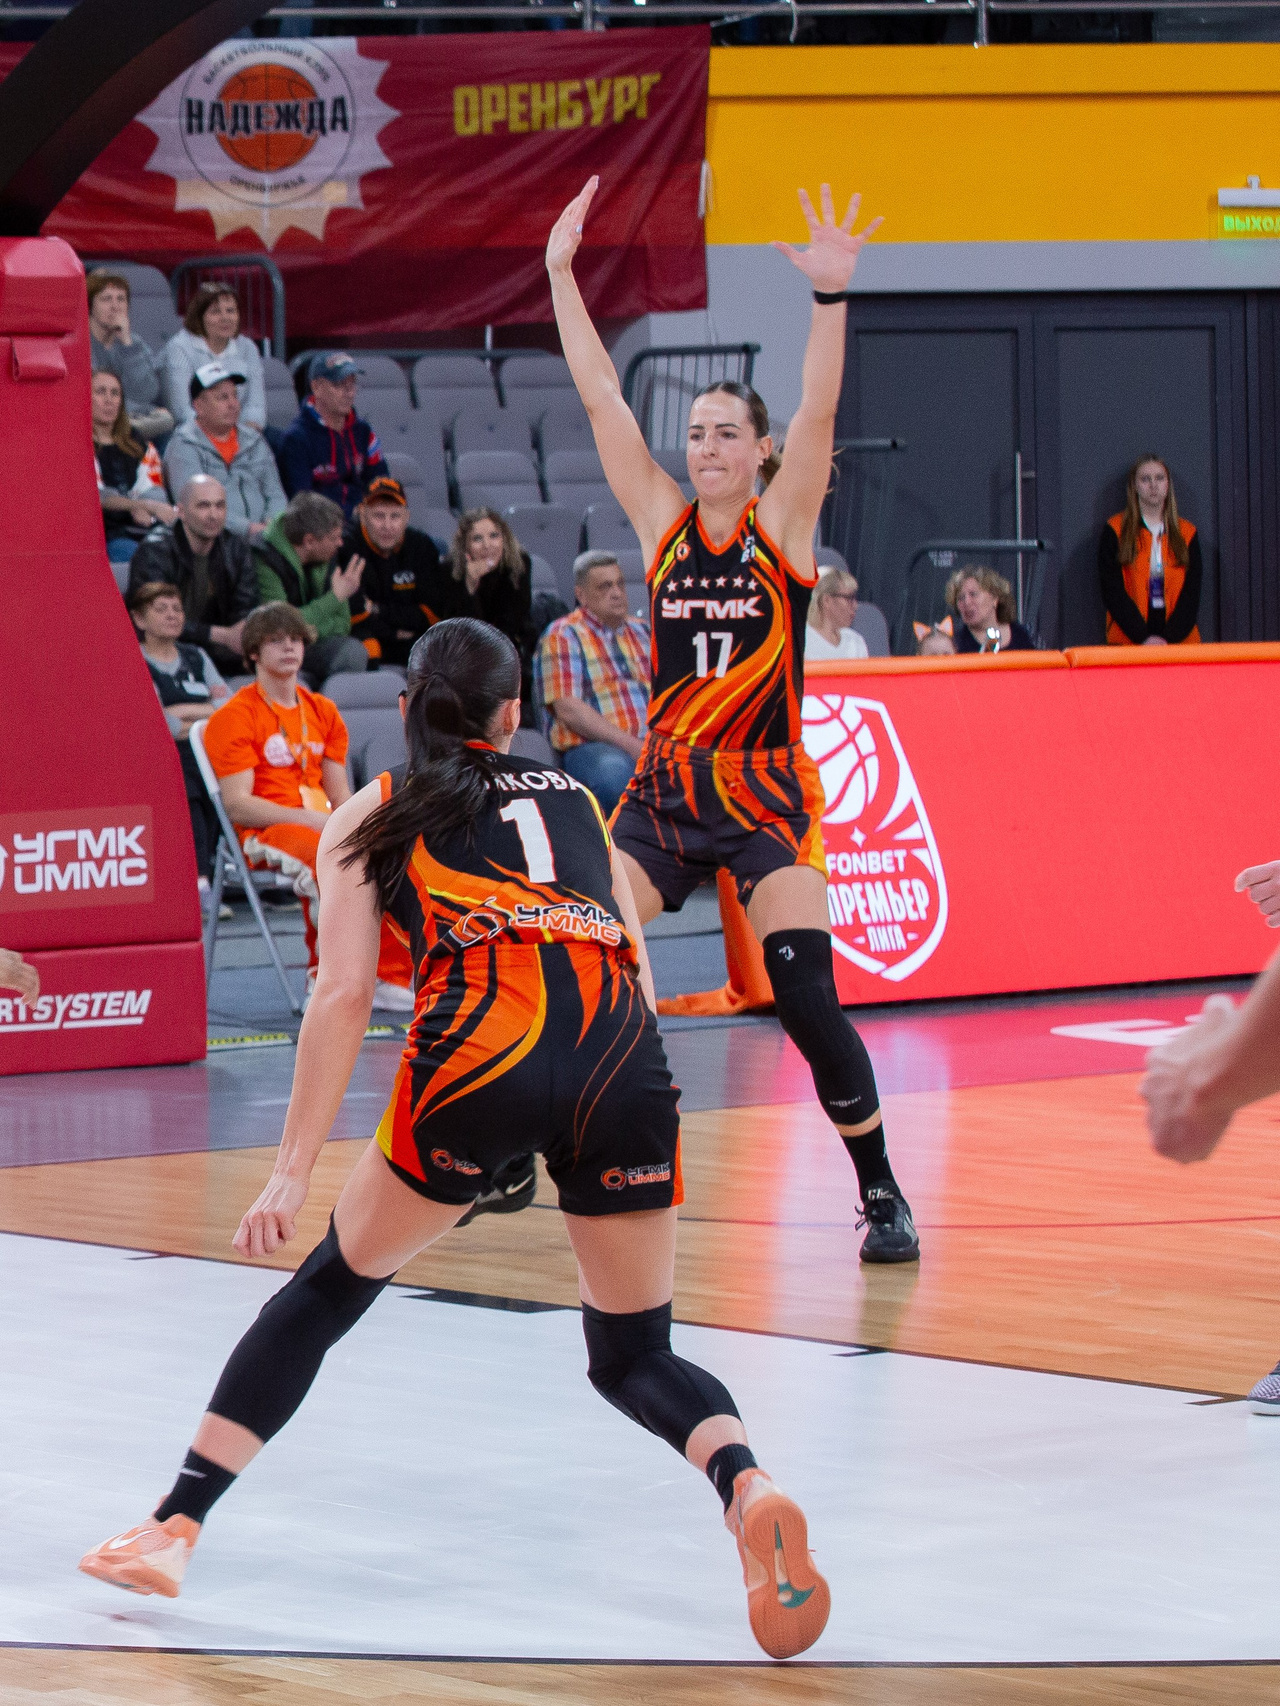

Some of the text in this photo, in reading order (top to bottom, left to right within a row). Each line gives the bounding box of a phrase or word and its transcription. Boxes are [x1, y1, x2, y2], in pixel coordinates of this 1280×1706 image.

[186, 95, 349, 136] НАДЕЖДА
[453, 72, 662, 136] ОРЕНБУРГ
[661, 595, 765, 619] УГМК
[692, 631, 733, 678] 17
[13, 825, 146, 864] УГМК
[499, 798, 558, 884] 1
[13, 857, 148, 894] UMMC
[825, 849, 908, 876] FONBET
[827, 878, 930, 927] ПРЕМЬЕР
[866, 924, 908, 953] ЛИГА
